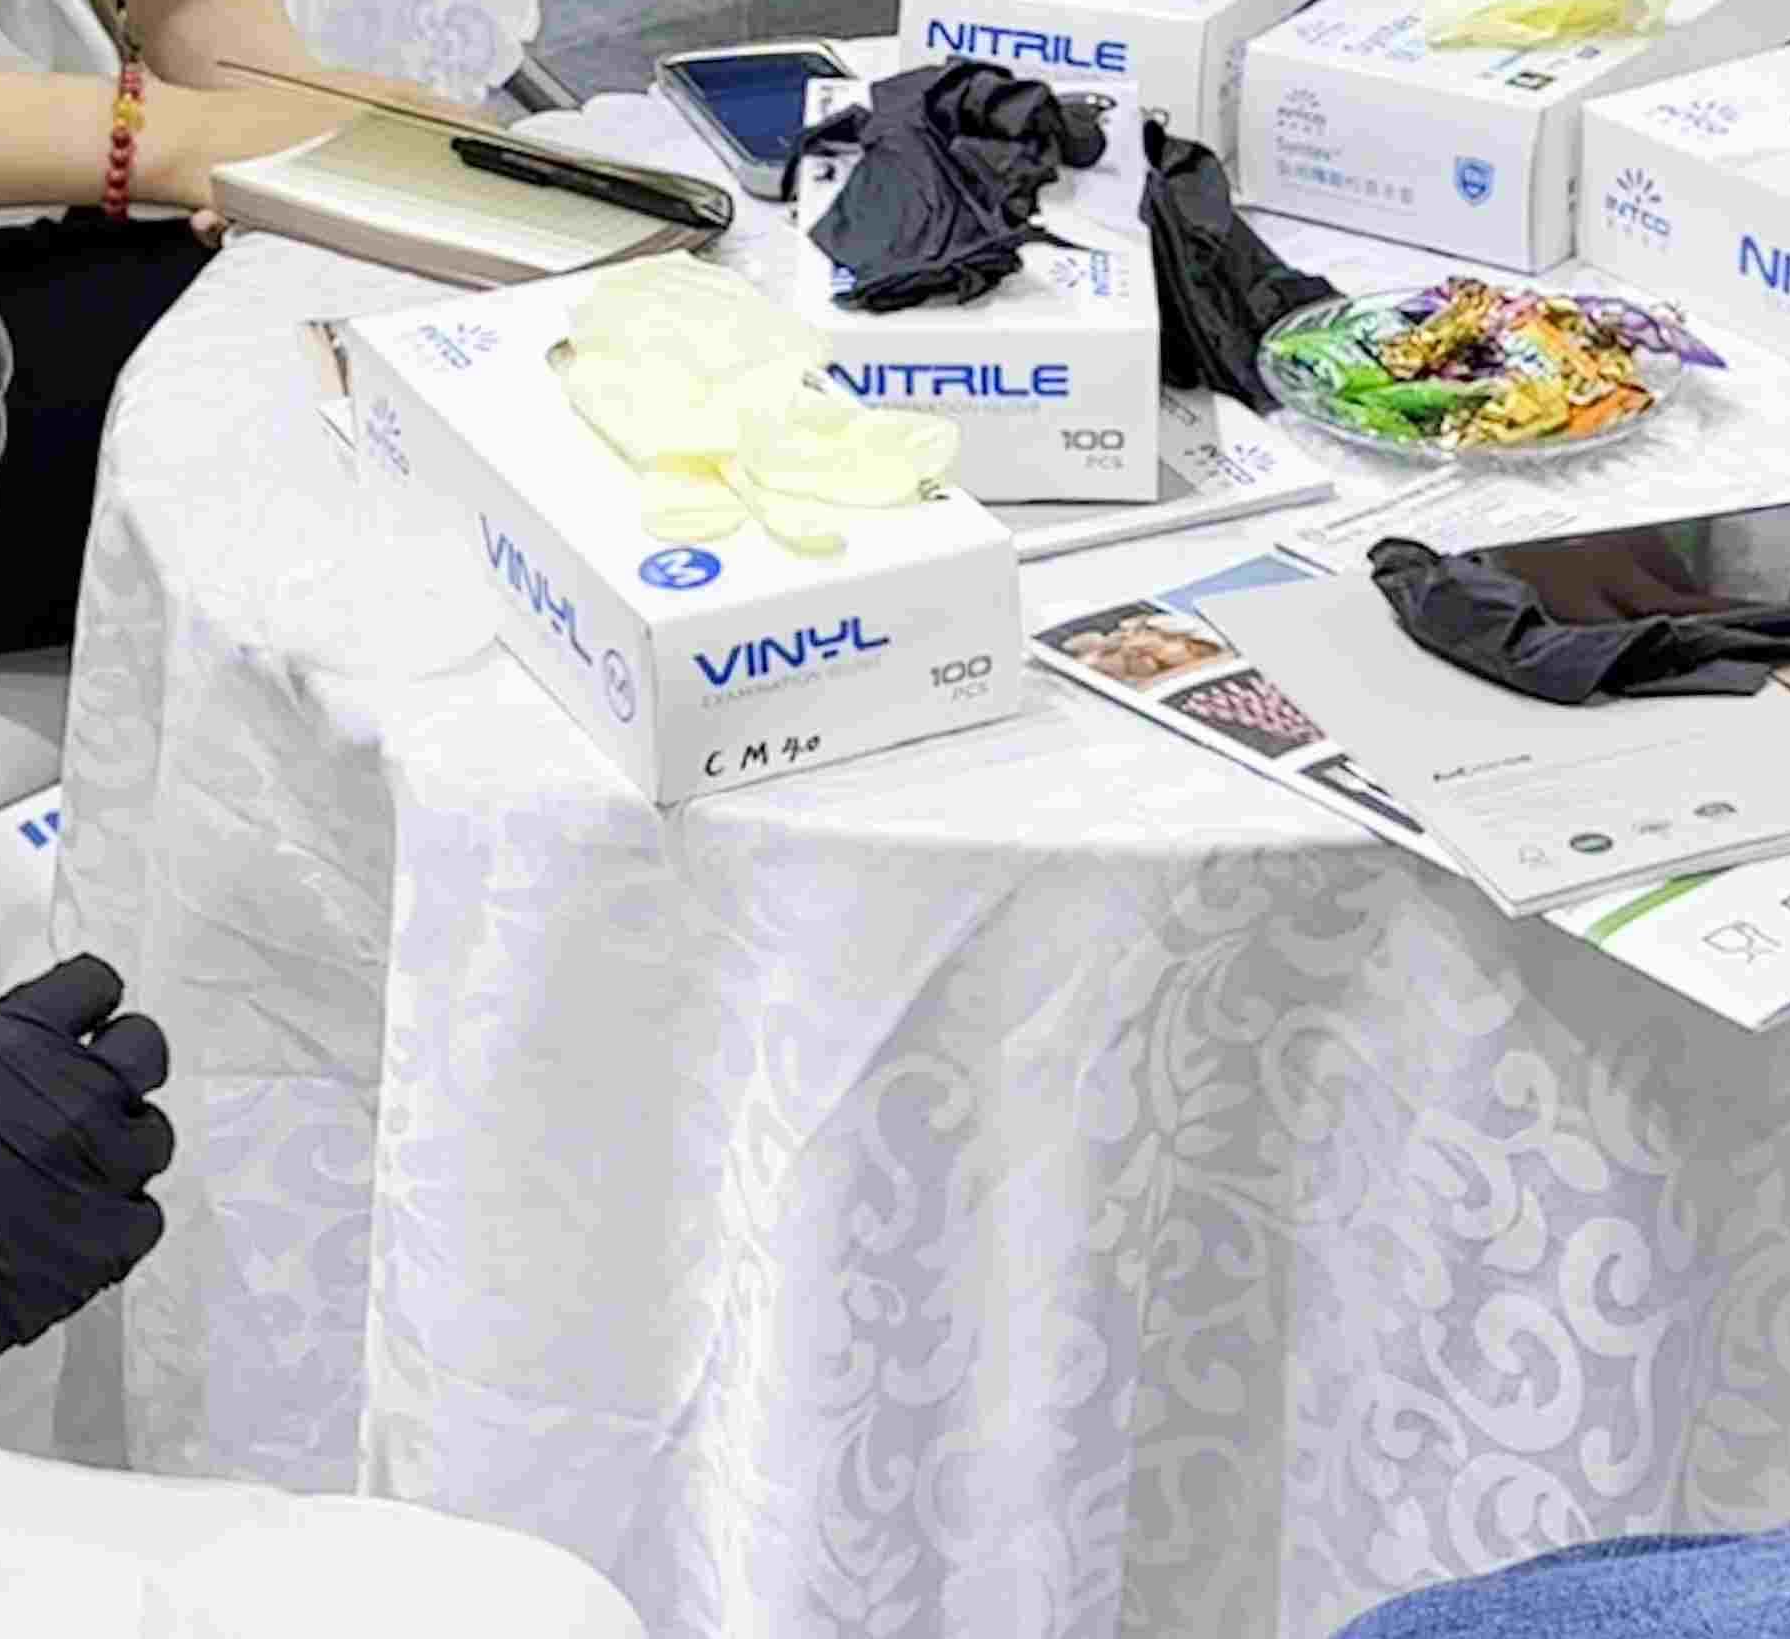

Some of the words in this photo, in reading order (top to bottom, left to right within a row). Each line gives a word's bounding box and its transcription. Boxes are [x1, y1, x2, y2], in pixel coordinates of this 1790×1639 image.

[926, 20, 1128, 72] NITRILE
[826, 363, 1070, 397] NITRILE
[1059, 429, 1125, 451] 100
[480, 512, 594, 668] VINYL
[694, 616, 891, 686] VINYL
[929, 655, 992, 687] 100
